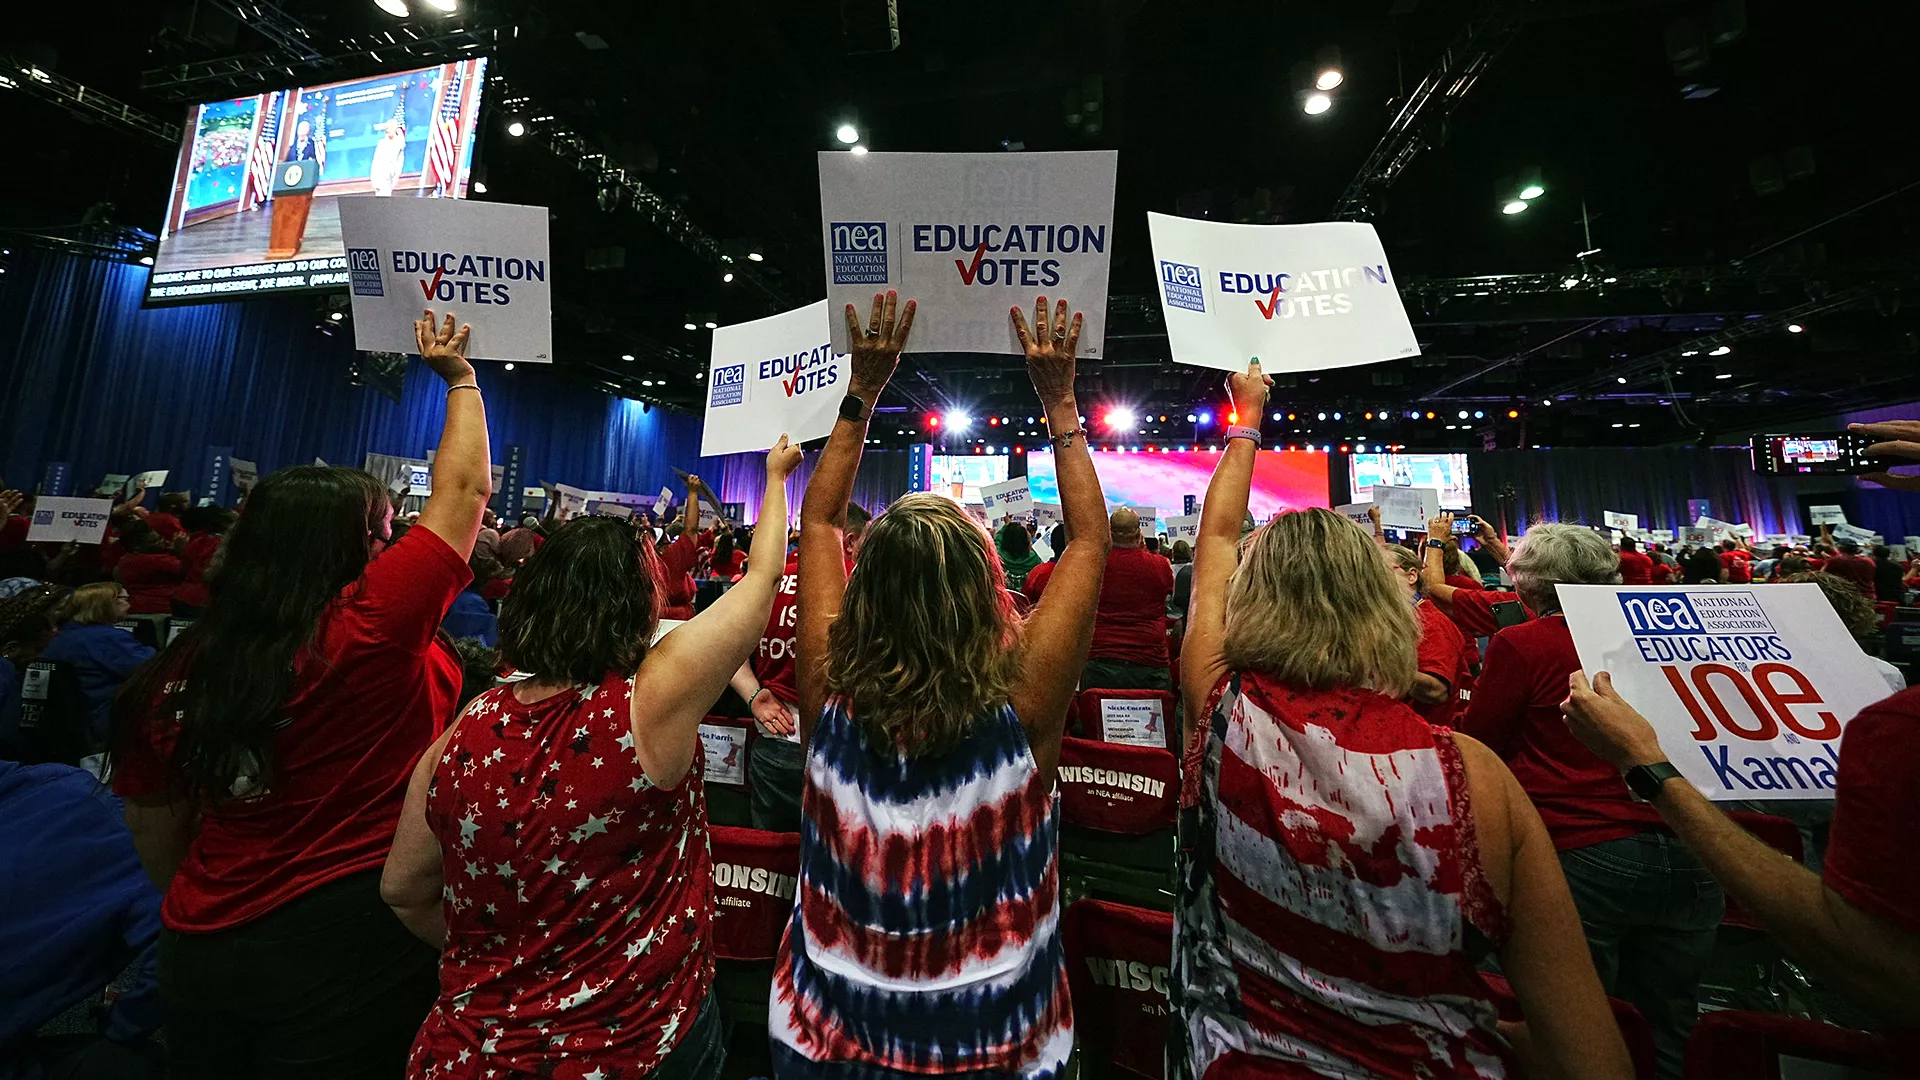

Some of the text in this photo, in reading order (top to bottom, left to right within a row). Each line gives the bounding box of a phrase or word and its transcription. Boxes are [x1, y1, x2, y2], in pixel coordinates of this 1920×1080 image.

[834, 225, 885, 250] nea
[914, 224, 1105, 253] EDUCATION
[350, 250, 378, 271] nea
[835, 255, 885, 263] NATIONAL
[184, 270, 201, 281] ARE
[202, 269, 213, 279] TO
[213, 268, 232, 278] OUR
[232, 263, 276, 276] STUDENTS
[276, 262, 296, 273] AND
[296, 261, 308, 271] TO
[310, 259, 329, 270] OUR
[392, 251, 545, 281] EDUCATION
[836, 265, 885, 273] EDUCATION
[353, 273, 381, 281] NATIONAL
[836, 274, 886, 282] ASSOCIATION
[1162, 263, 1200, 287] nea
[1218, 265, 1388, 294] EDUCATION
[150, 287, 167, 297] THE
[166, 284, 212, 296] EDUCATION
[259, 278, 276, 289] JOE
[355, 287, 383, 296] ASSOCIATION
[1165, 284, 1202, 297] NATIONAL
[1166, 291, 1203, 304] EDUCATION
[1168, 299, 1204, 311] ASSOCIATION
[714, 366, 743, 386] nea
[712, 391, 741, 400] EDUCATION
[713, 385, 741, 394] NATIONAL
[711, 397, 741, 407] ASSOCIATION
[505, 447, 519, 516] TENNESSEE
[996, 487, 1029, 500] EDUCATION
[61, 511, 107, 521] EDUCATION
[1693, 597, 1754, 608] NATIONAL
[779, 605, 797, 627] IS
[1625, 596, 1699, 631] nea
[1700, 608, 1761, 619] EDUCATION
[1707, 620, 1768, 630] ASSOCIATION
[1634, 635, 1792, 662] EDUCATORS
[1734, 662, 1750, 673] FOR
[1783, 733, 1800, 745] AND
[1058, 766, 1165, 798] WISCONSIN
[1096, 789, 1111, 798] NEA
[1112, 792, 1134, 802] affiliate
[711, 862, 797, 900] ONSIN
[721, 895, 752, 908] affiliate
[1142, 1003, 1154, 1014] an
